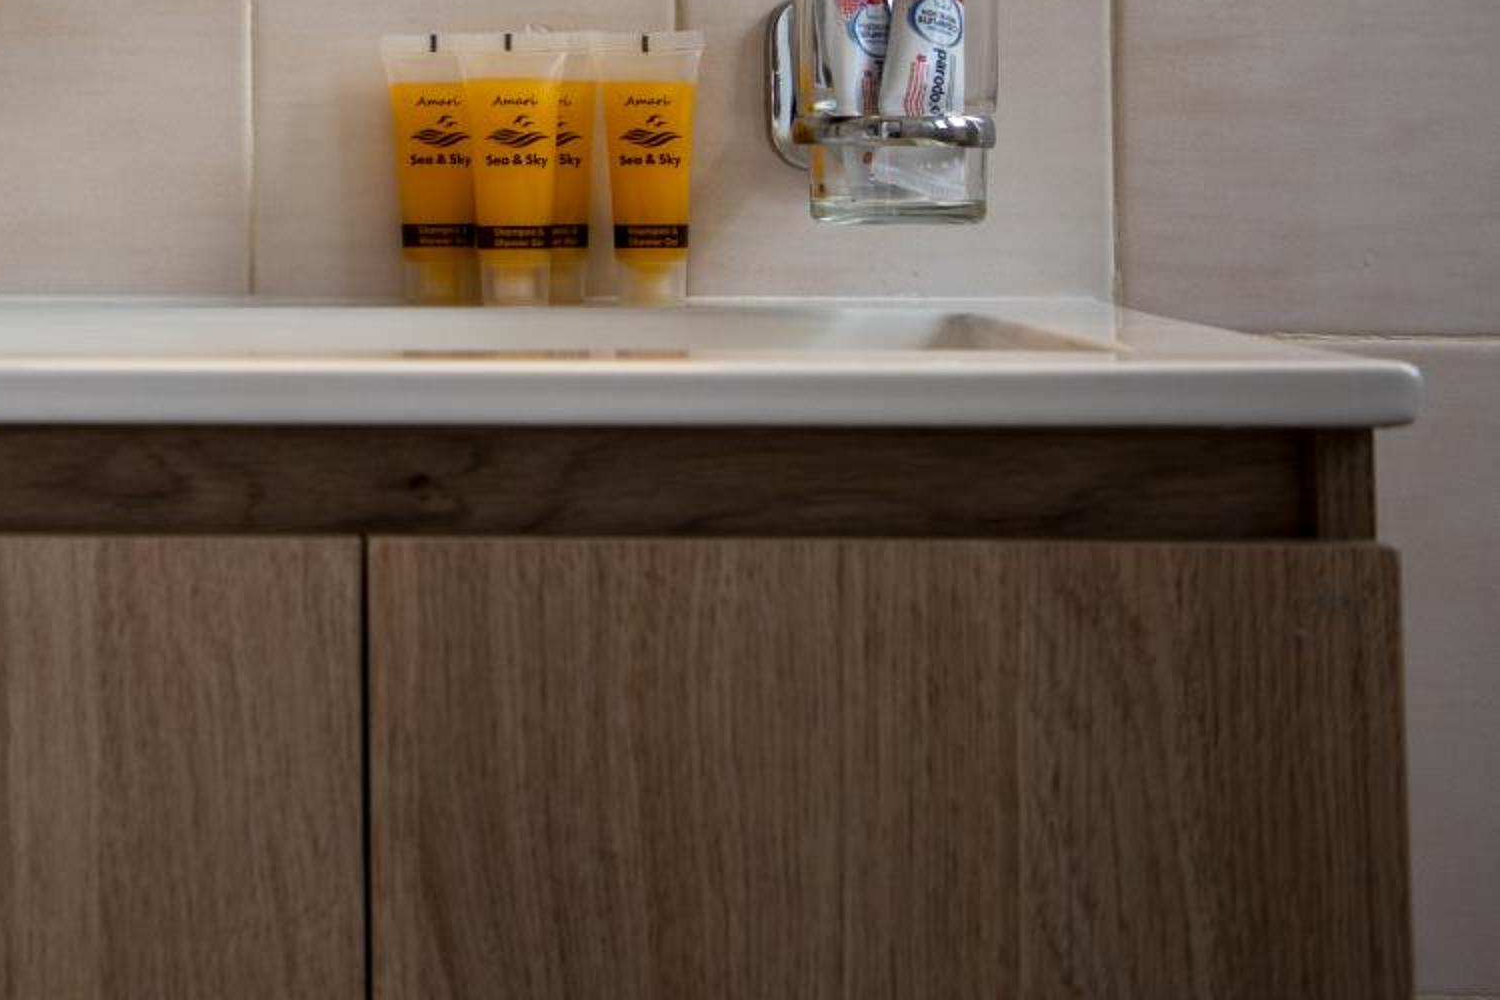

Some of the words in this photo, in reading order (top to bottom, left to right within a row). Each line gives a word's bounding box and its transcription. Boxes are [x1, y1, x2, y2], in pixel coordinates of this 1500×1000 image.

[415, 95, 462, 108] Amari
[491, 95, 539, 108] Amari
[623, 95, 671, 108] Amari
[410, 154, 435, 166] Sea
[436, 154, 447, 166] &
[449, 154, 471, 168] Sky
[485, 154, 511, 166] Sea
[513, 154, 523, 166] &
[525, 154, 548, 168] Sky
[558, 154, 581, 168] Sky
[619, 154, 643, 166] Sea
[645, 154, 655, 166] &
[658, 154, 682, 168] Sky
